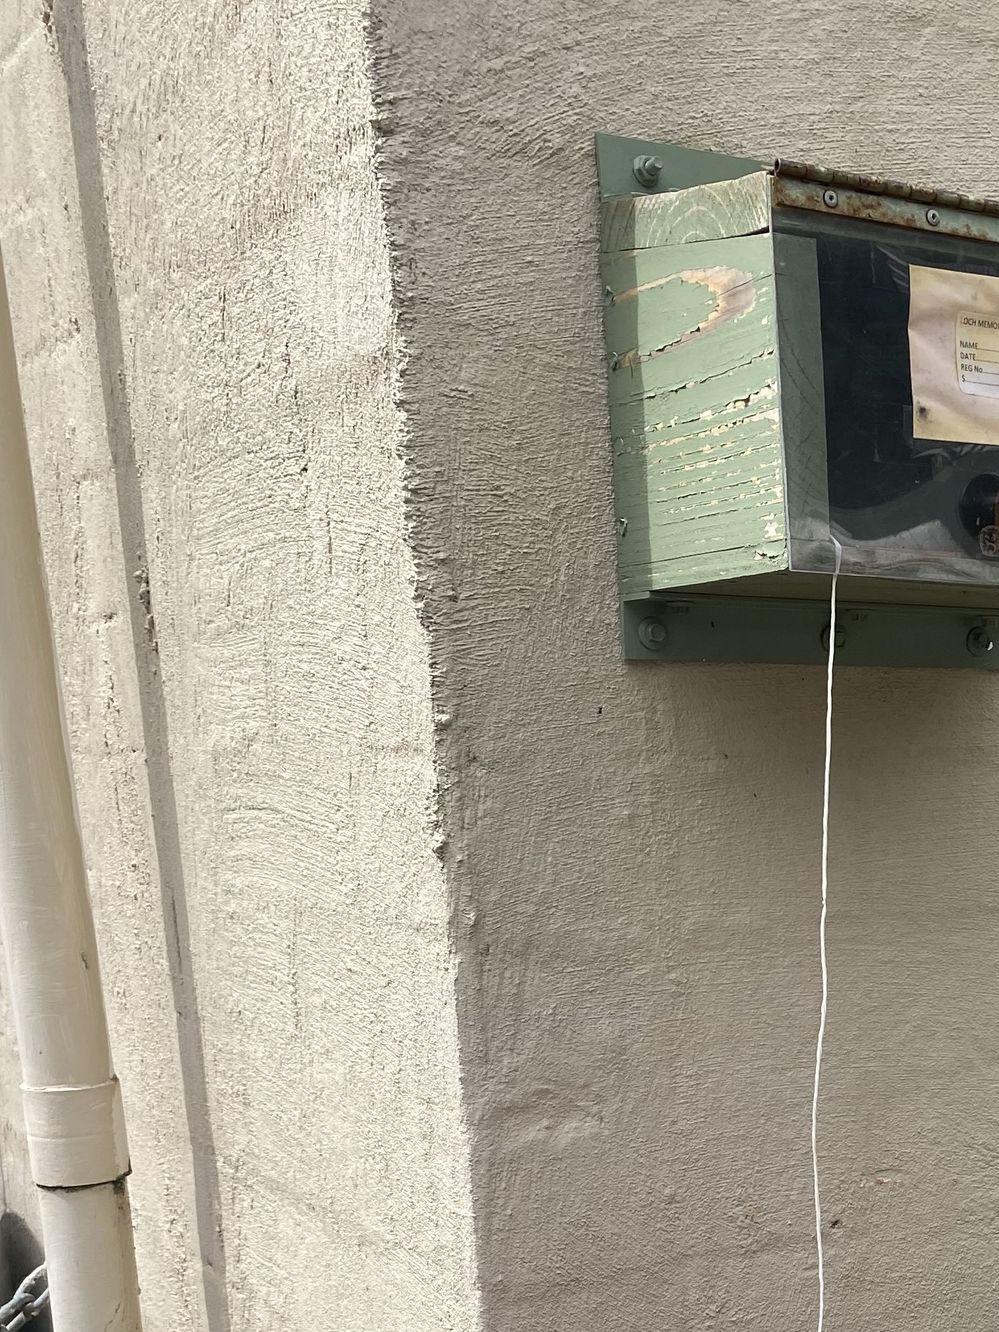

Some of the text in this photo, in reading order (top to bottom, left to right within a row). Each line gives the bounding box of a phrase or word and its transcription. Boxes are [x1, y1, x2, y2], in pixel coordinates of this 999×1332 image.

[960, 340, 978, 349] NAME
[960, 352, 976, 361] DATE
[961, 363, 972, 372] REG
